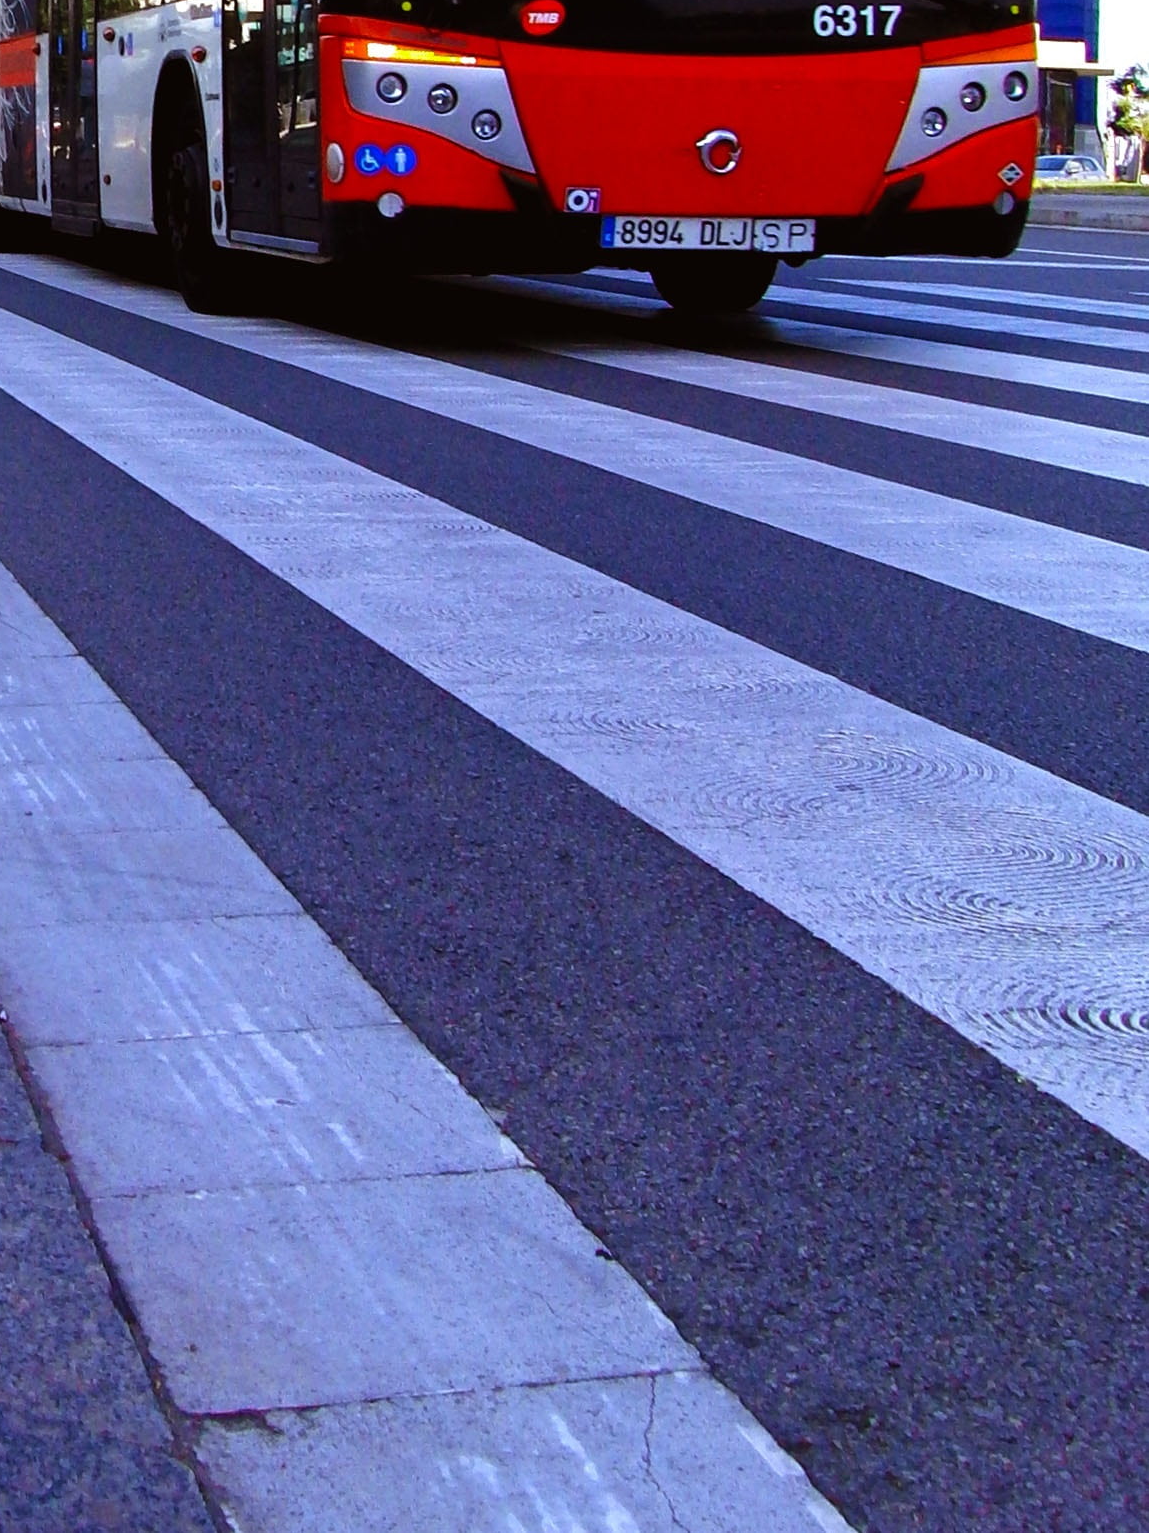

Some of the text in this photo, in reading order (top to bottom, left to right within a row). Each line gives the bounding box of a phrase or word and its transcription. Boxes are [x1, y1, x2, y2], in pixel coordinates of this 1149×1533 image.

[528, 12, 559, 24] TMB
[813, 4, 902, 37] 6317
[620, 220, 748, 246] 8994 DLJ
